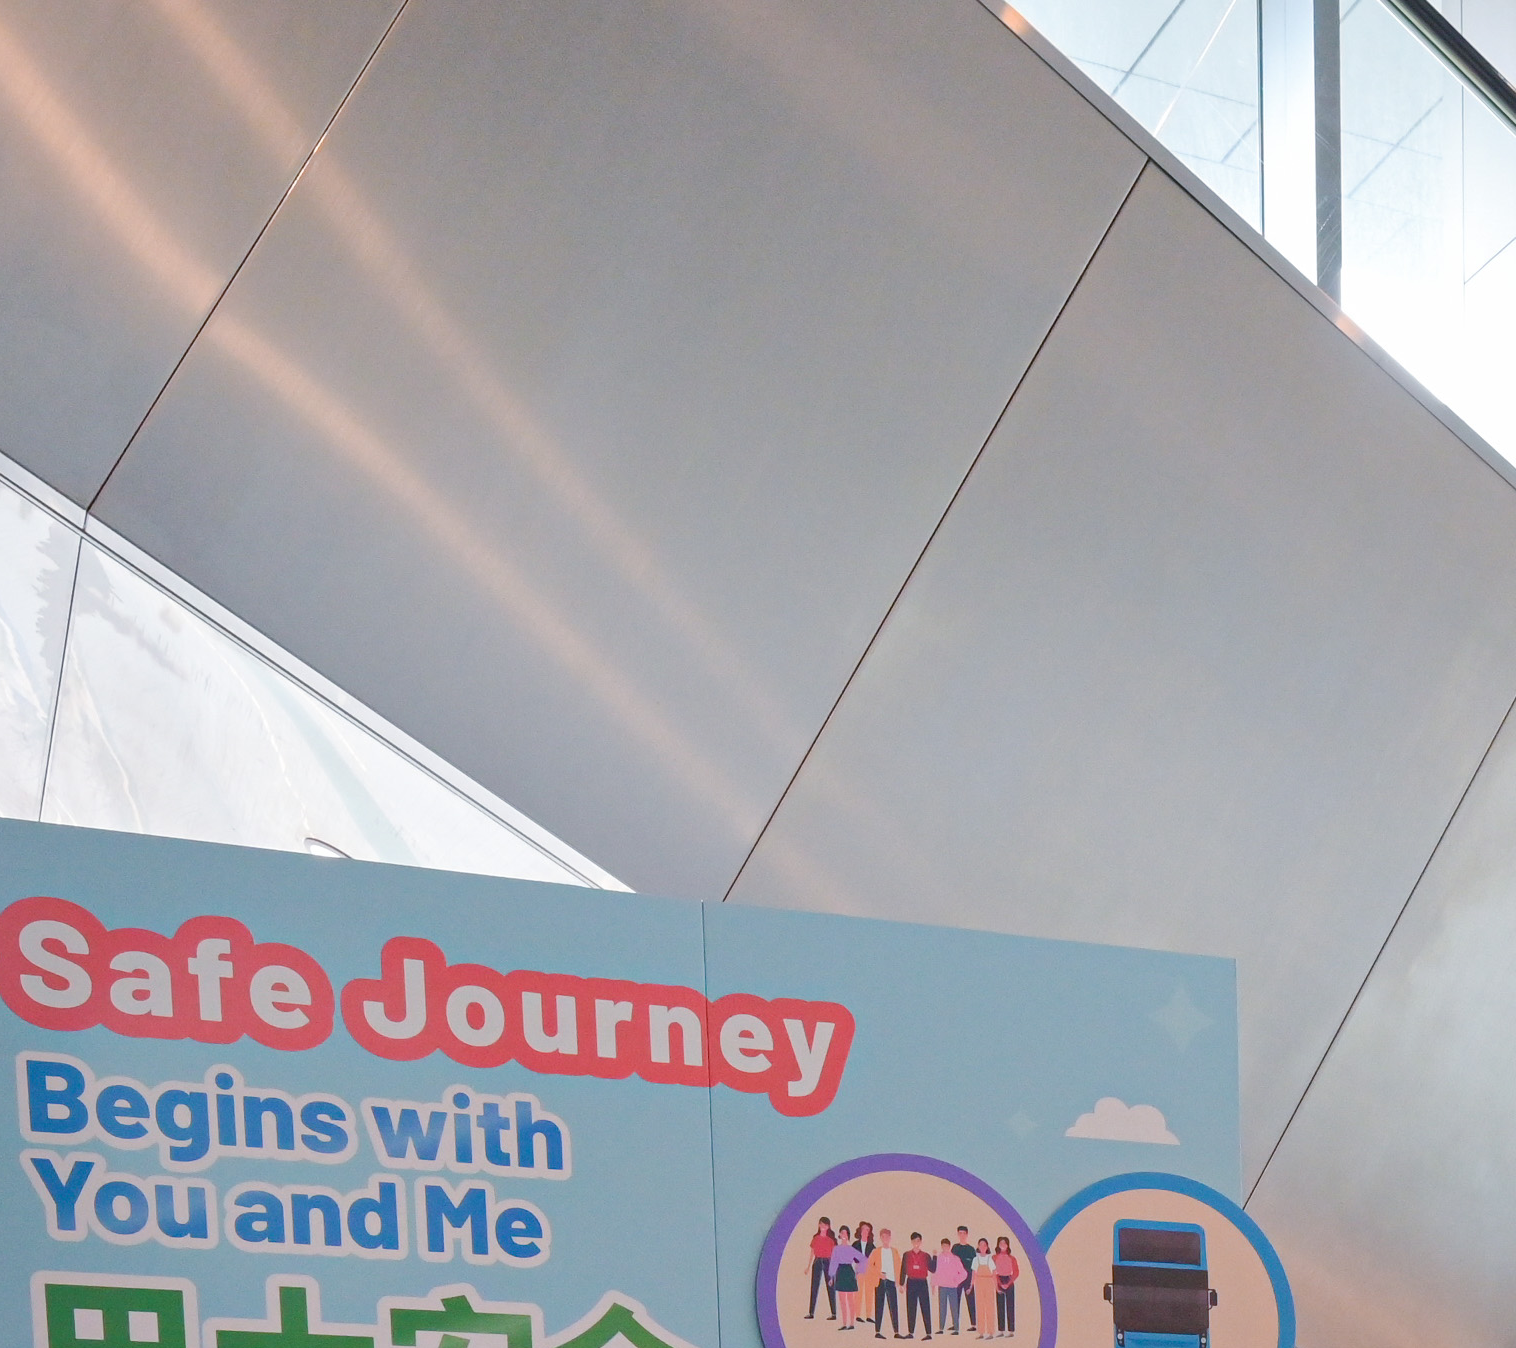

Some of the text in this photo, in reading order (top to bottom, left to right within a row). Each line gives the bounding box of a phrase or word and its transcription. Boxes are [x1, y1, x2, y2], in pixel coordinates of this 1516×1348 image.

[18, 920, 834, 1097] Safe Journey
[25, 1060, 564, 1171] Begins with
[30, 1158, 543, 1259] You and Me
